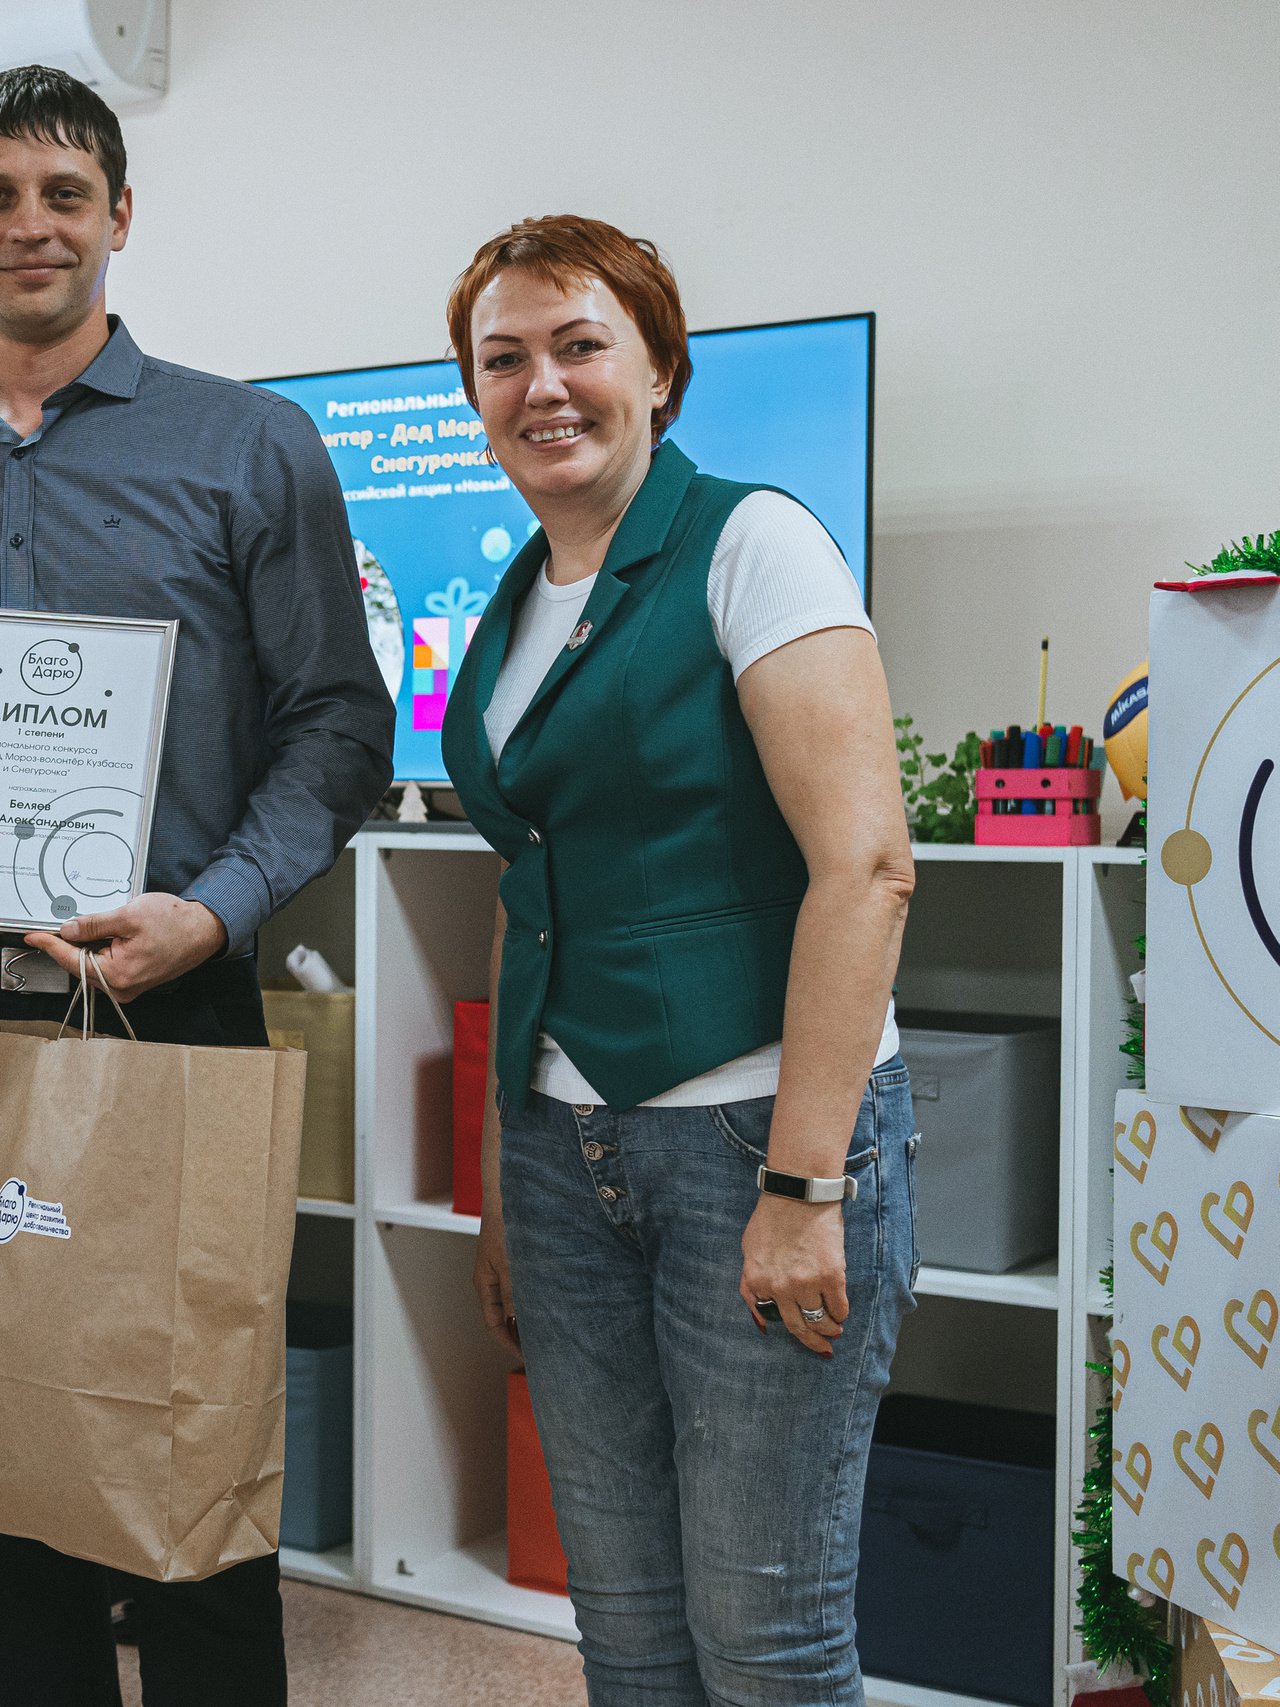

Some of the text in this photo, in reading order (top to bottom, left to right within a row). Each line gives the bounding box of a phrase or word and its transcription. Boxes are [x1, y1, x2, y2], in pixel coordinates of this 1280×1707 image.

[326, 387, 468, 418] Региональный
[390, 423, 434, 447] Дед
[438, 418, 486, 441] Мор
[342, 483, 407, 501] ссийской
[408, 482, 452, 499] акции
[27, 652, 69, 667] Благо
[32, 666, 75, 681] Дарю
[1111, 686, 1148, 727] MIKAS
[24, 728, 65, 739] степени
[52, 744, 98, 756] конкурса
[86, 758, 133, 770] Кузбасса
[8, 784, 57, 795] награждается
[9, 799, 51, 811] Беляев
